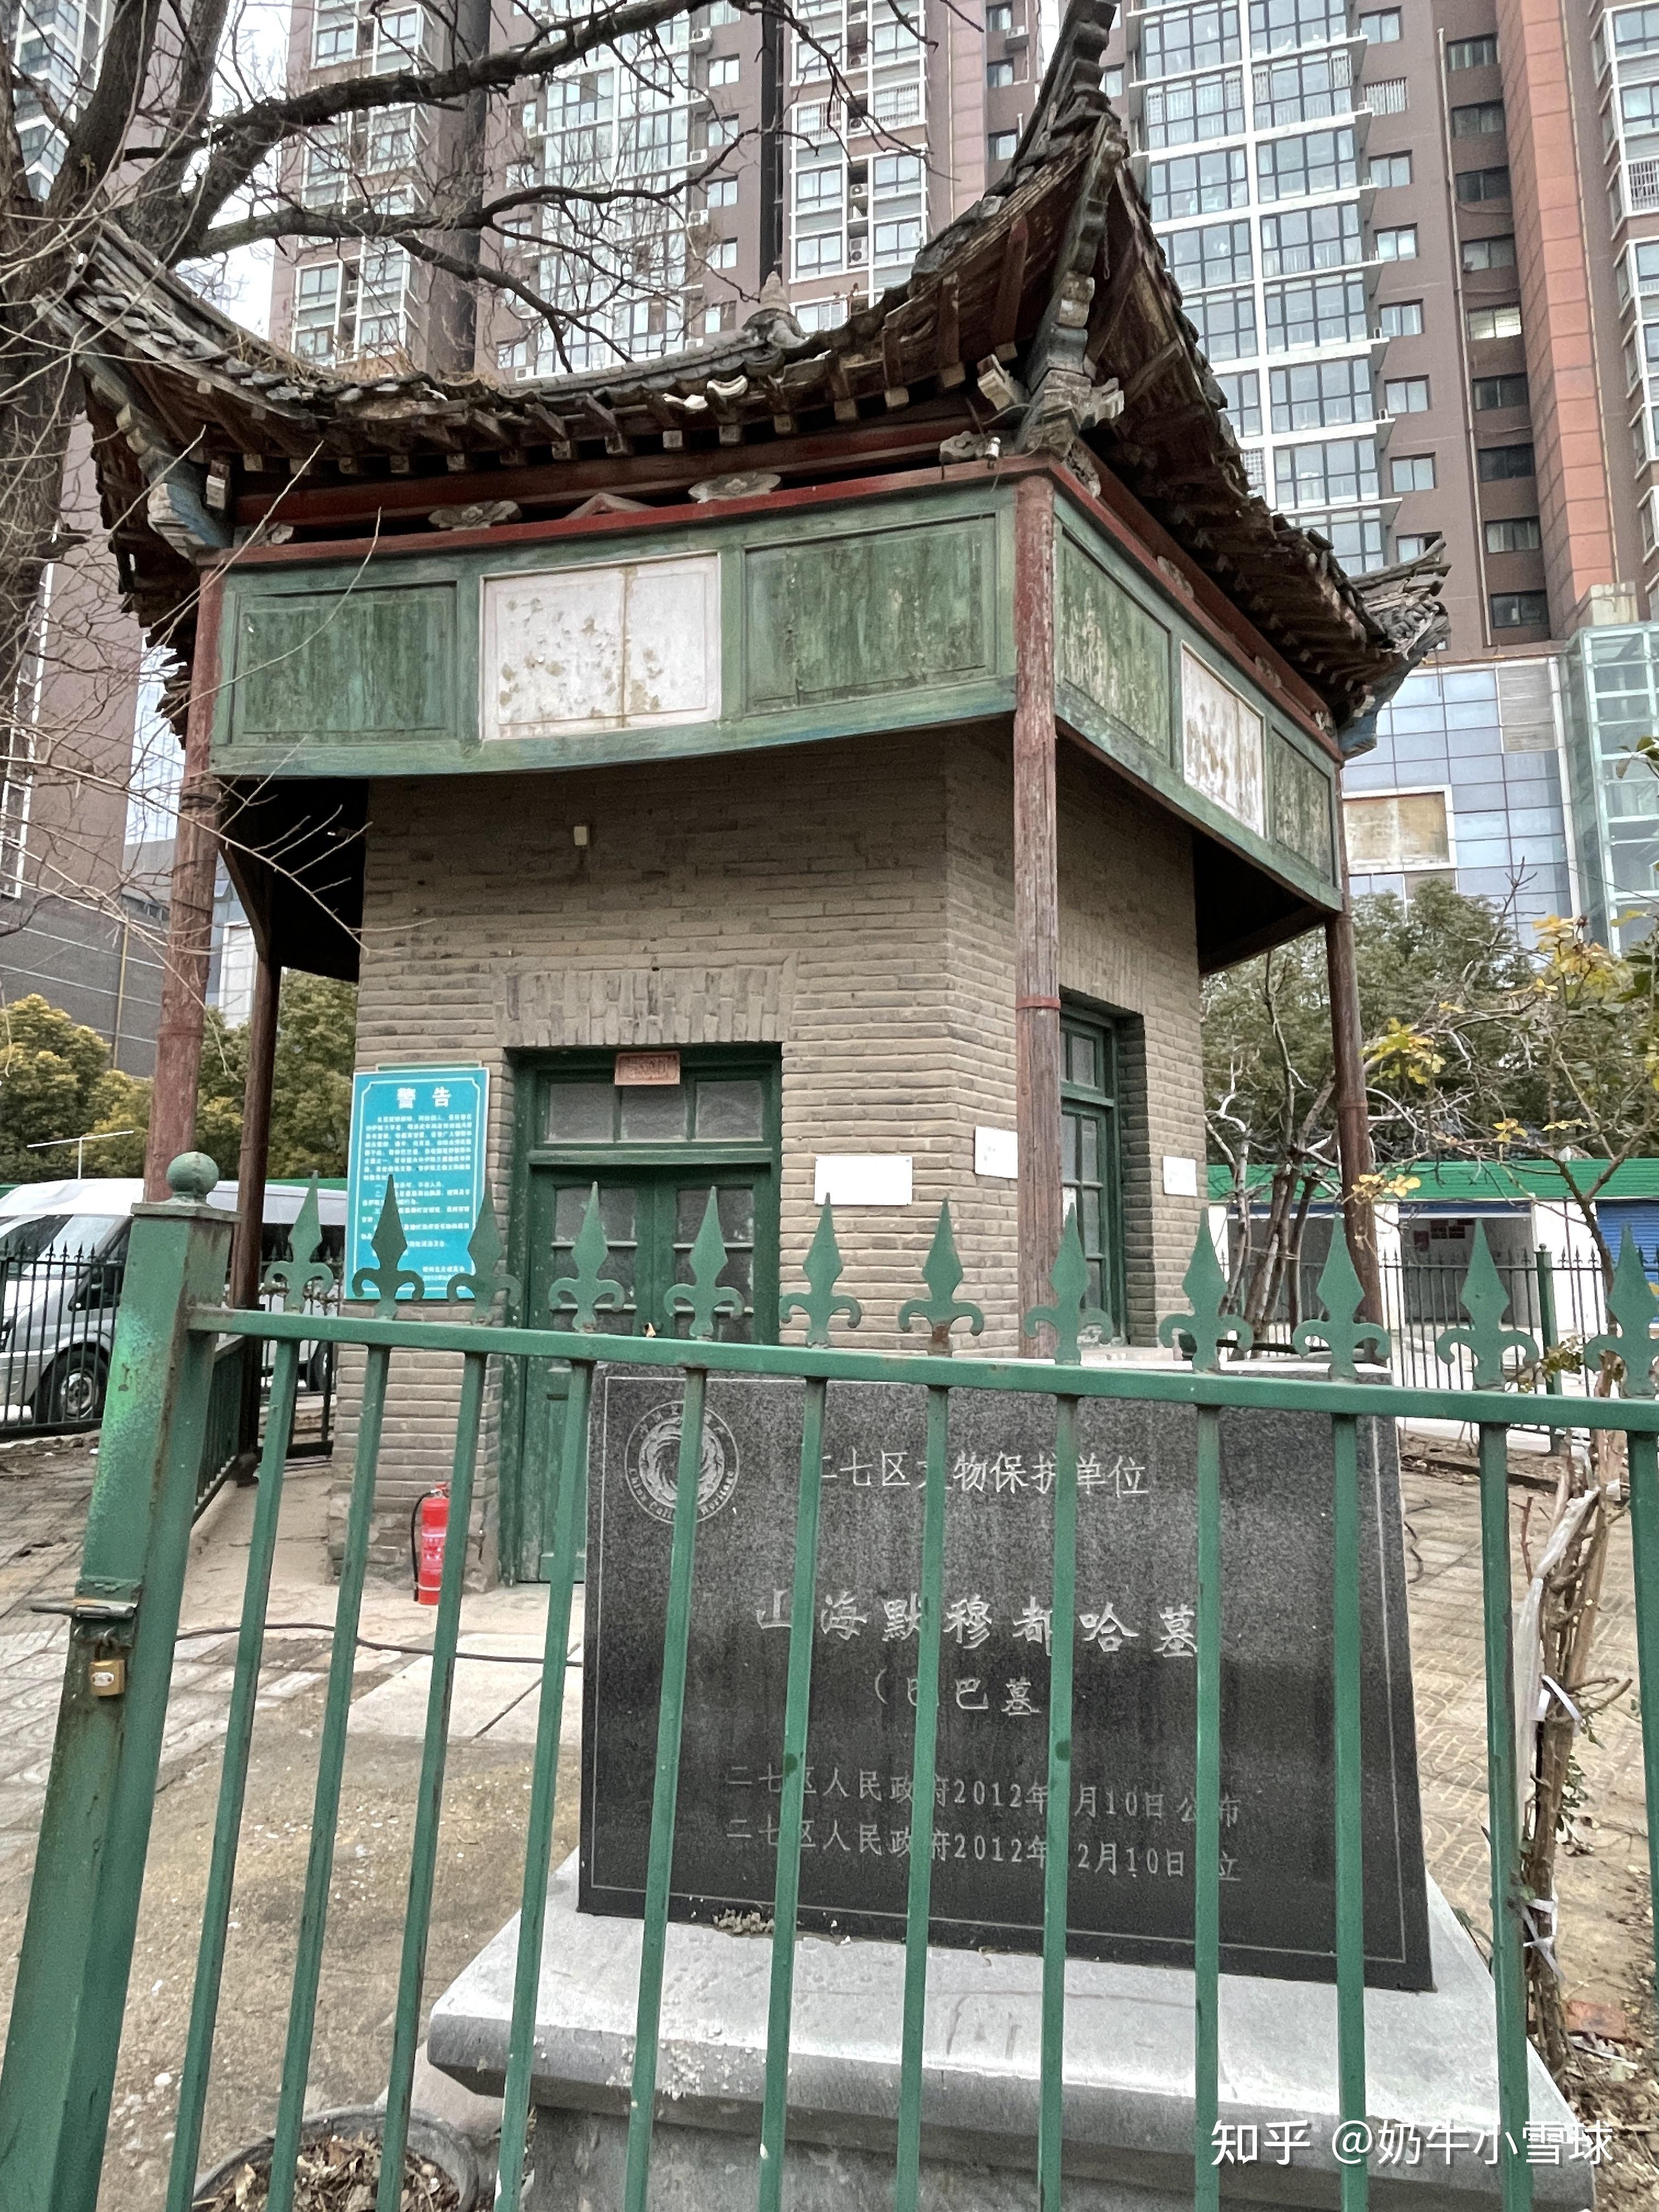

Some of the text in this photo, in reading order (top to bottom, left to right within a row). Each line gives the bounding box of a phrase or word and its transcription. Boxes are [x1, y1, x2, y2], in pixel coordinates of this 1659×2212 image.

[396, 1087, 452, 1109] 警告
[821, 1445, 1149, 1499] 二七区物保护单位
